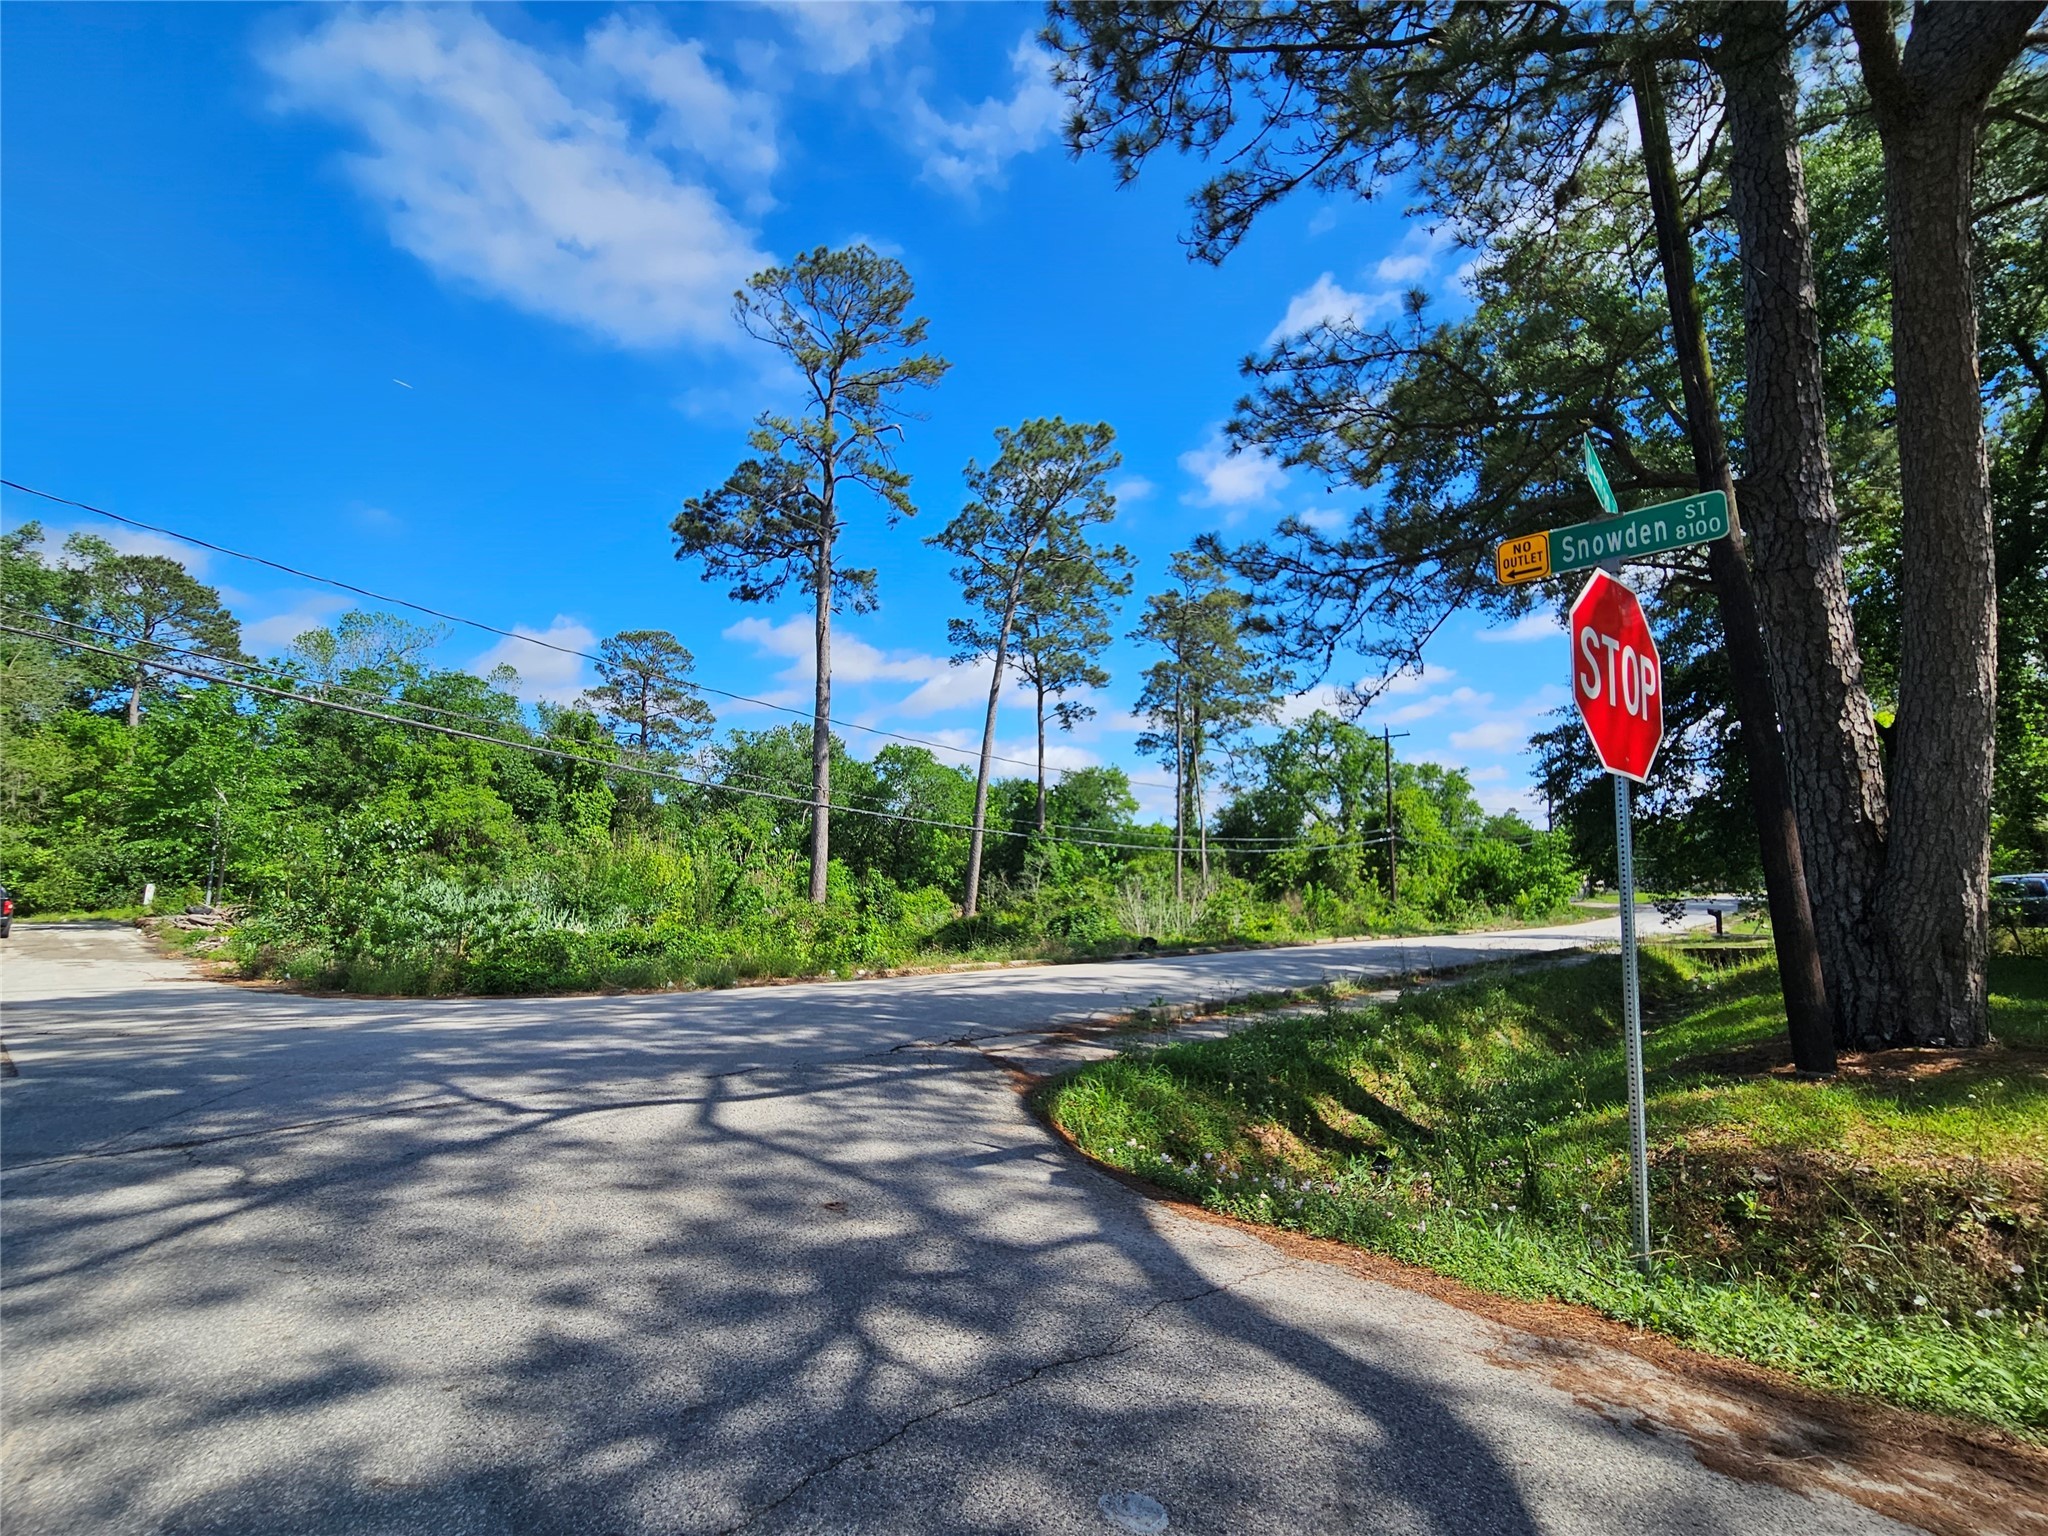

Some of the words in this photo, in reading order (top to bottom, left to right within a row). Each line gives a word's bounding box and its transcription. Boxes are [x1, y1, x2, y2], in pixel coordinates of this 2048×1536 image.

[1685, 501, 1707, 519] ST
[1676, 517, 1721, 541] 8100
[1513, 541, 1531, 553] NO
[1562, 519, 1667, 563] Snowden
[1503, 551, 1544, 570] OUTLET
[1580, 626, 1656, 721] STOP
